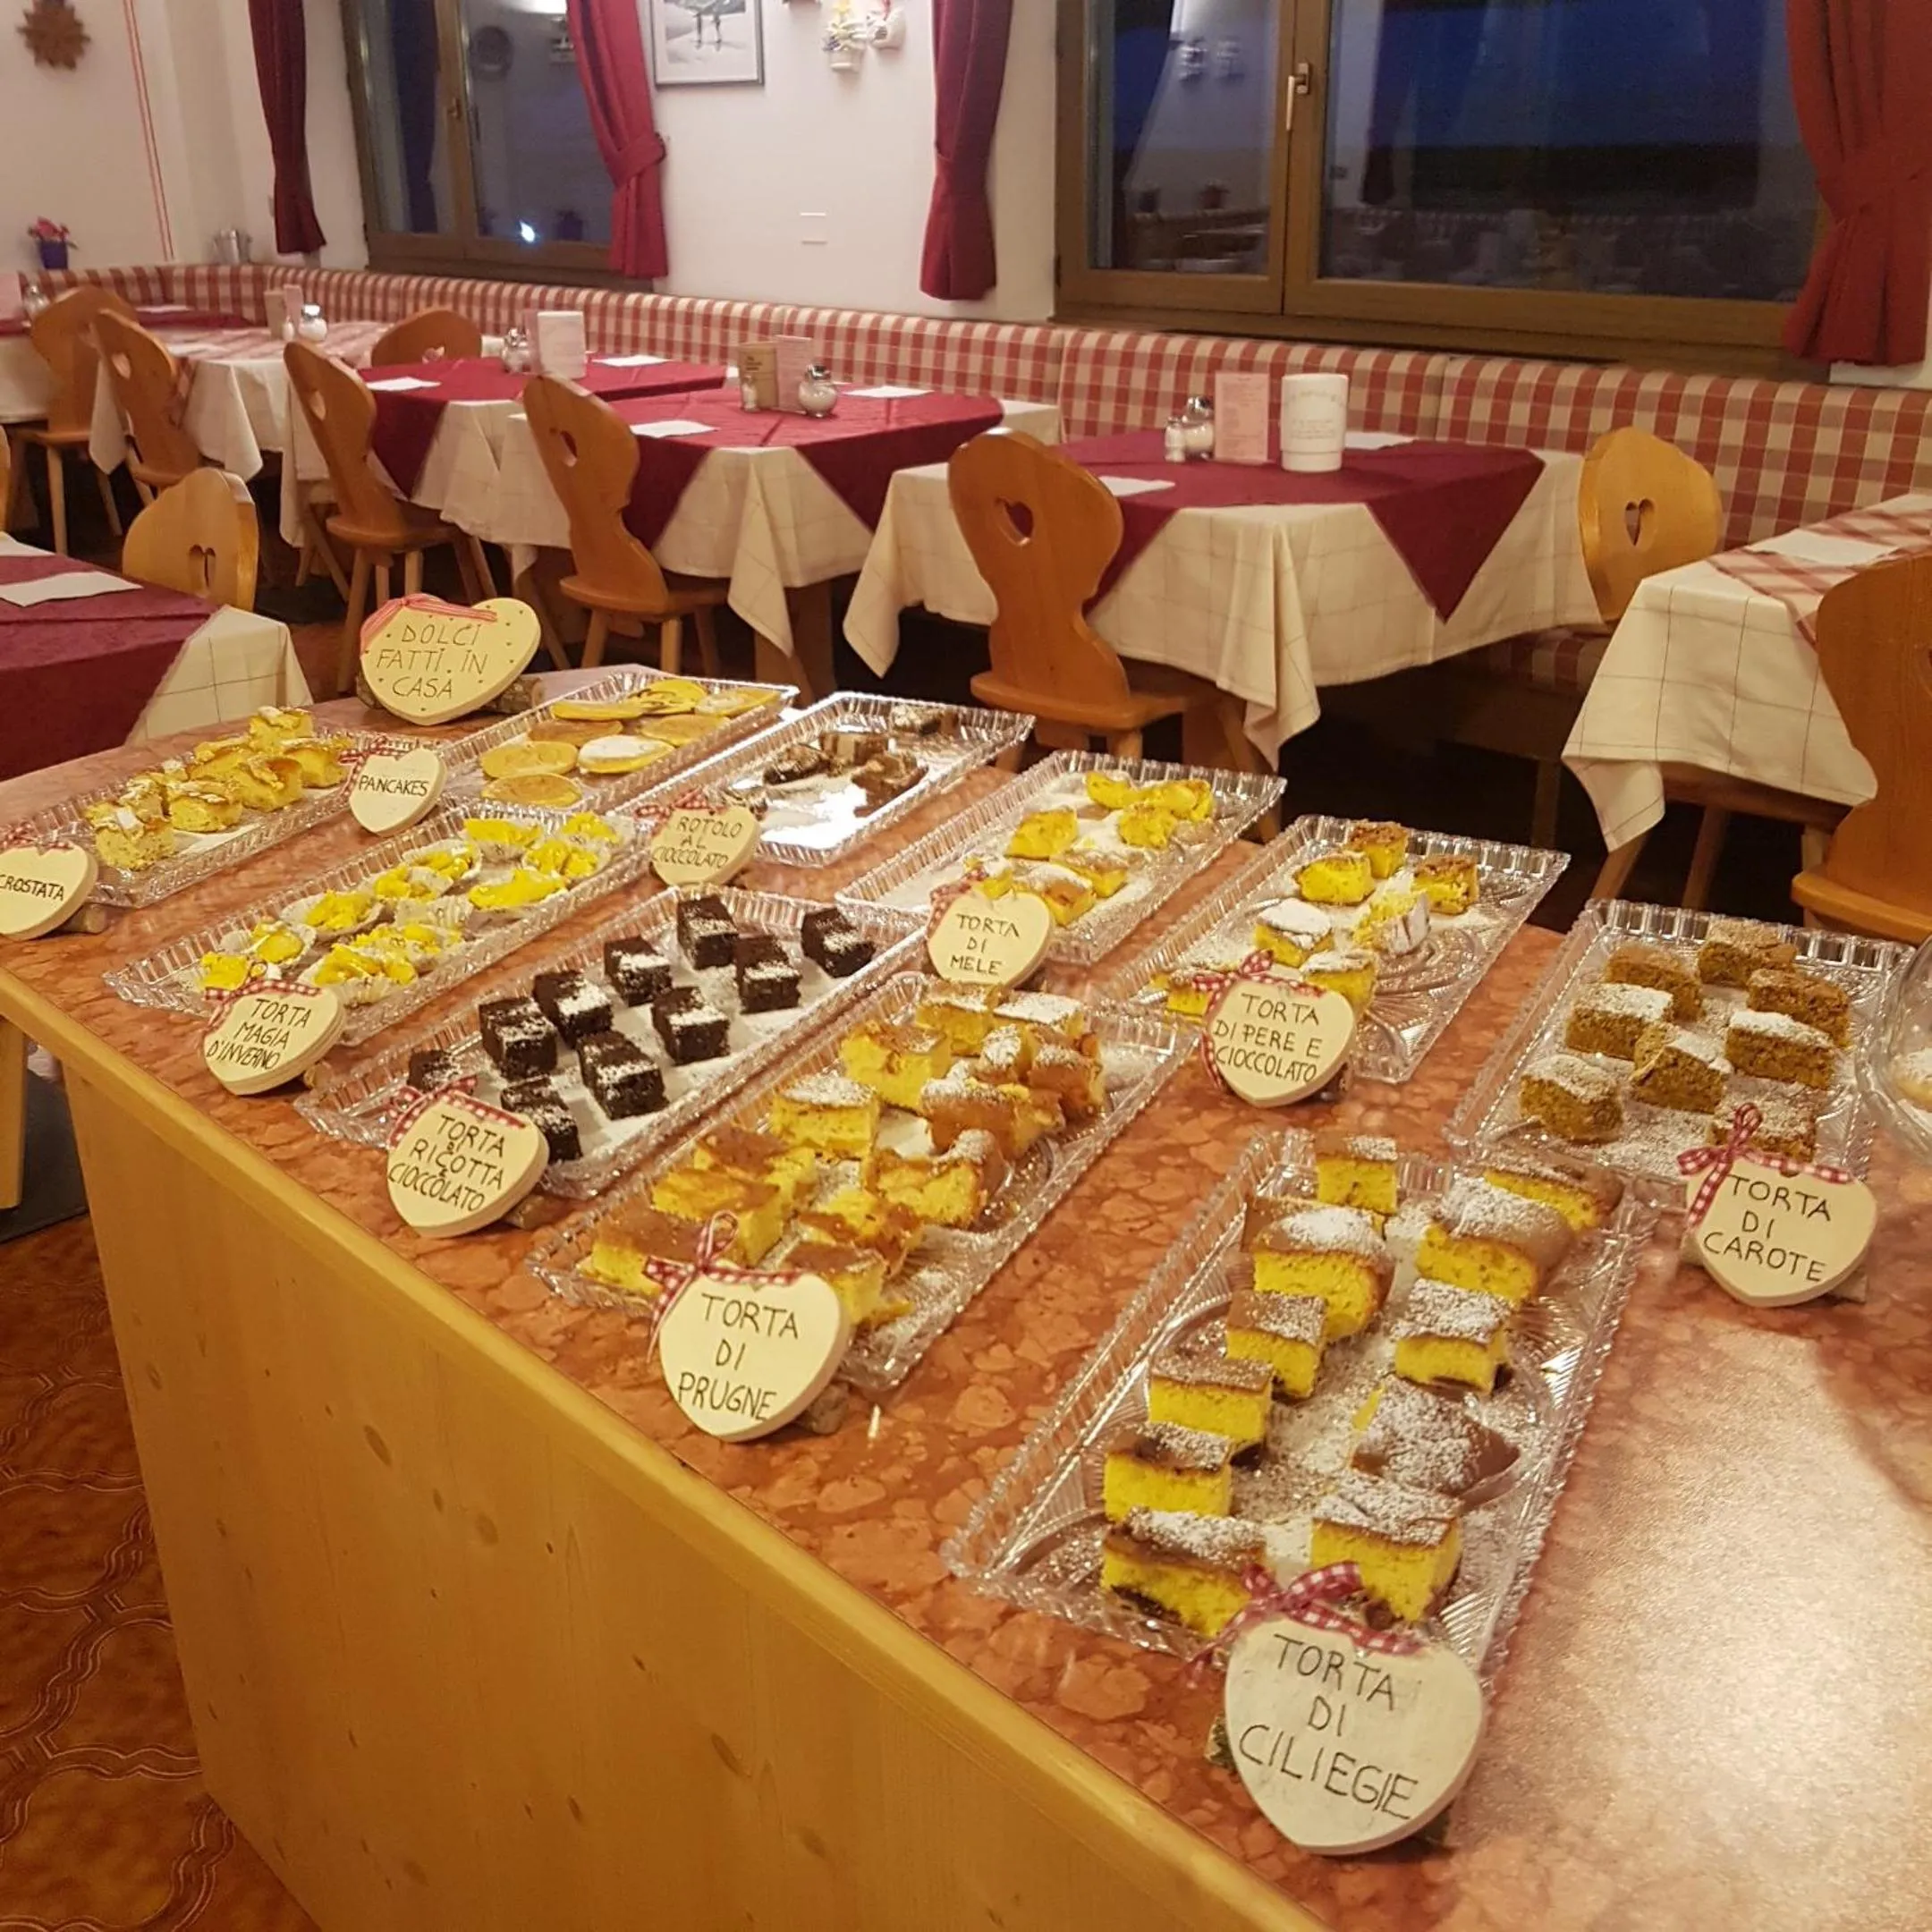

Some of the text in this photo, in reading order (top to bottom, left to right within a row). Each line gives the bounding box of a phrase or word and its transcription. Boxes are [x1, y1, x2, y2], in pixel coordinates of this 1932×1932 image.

[401, 624, 481, 646] DOLCI
[377, 648, 488, 674] FATTI IN
[392, 677, 453, 699] CASA
[359, 775, 429, 797] PANCAKES
[676, 816, 742, 838] ROTOLO
[681, 835, 707, 850] AL
[651, 846, 729, 869] CIOCCOLATO
[955, 913, 1020, 938] TORTA
[966, 936, 987, 953] DI
[950, 954, 1002, 976] MELE
[250, 998, 311, 1028] TORTA
[1241, 992, 1319, 1026] TORTA
[233, 1021, 290, 1049] MAGIA
[1213, 1019, 1322, 1058] DI PERE E
[207, 1039, 281, 1071] D'INVERNO
[1216, 1046, 1318, 1082] CIOCCOLATO
[436, 1114, 504, 1157] TORTA
[409, 1138, 504, 1190] RICOTTA
[388, 1163, 485, 1211] CIOCCOLATO
[1726, 1174, 1831, 1222] TORTA
[1741, 1210, 1775, 1239] DI
[1703, 1231, 1826, 1282] CAROTE
[701, 1292, 798, 1340] TORTA
[716, 1338, 746, 1370] DI
[678, 1371, 777, 1420] PRUGNE
[1274, 1633, 1394, 1711] TORTA
[1308, 1695, 1346, 1737] DI
[1239, 1724, 1419, 1819] CILIEGIE
